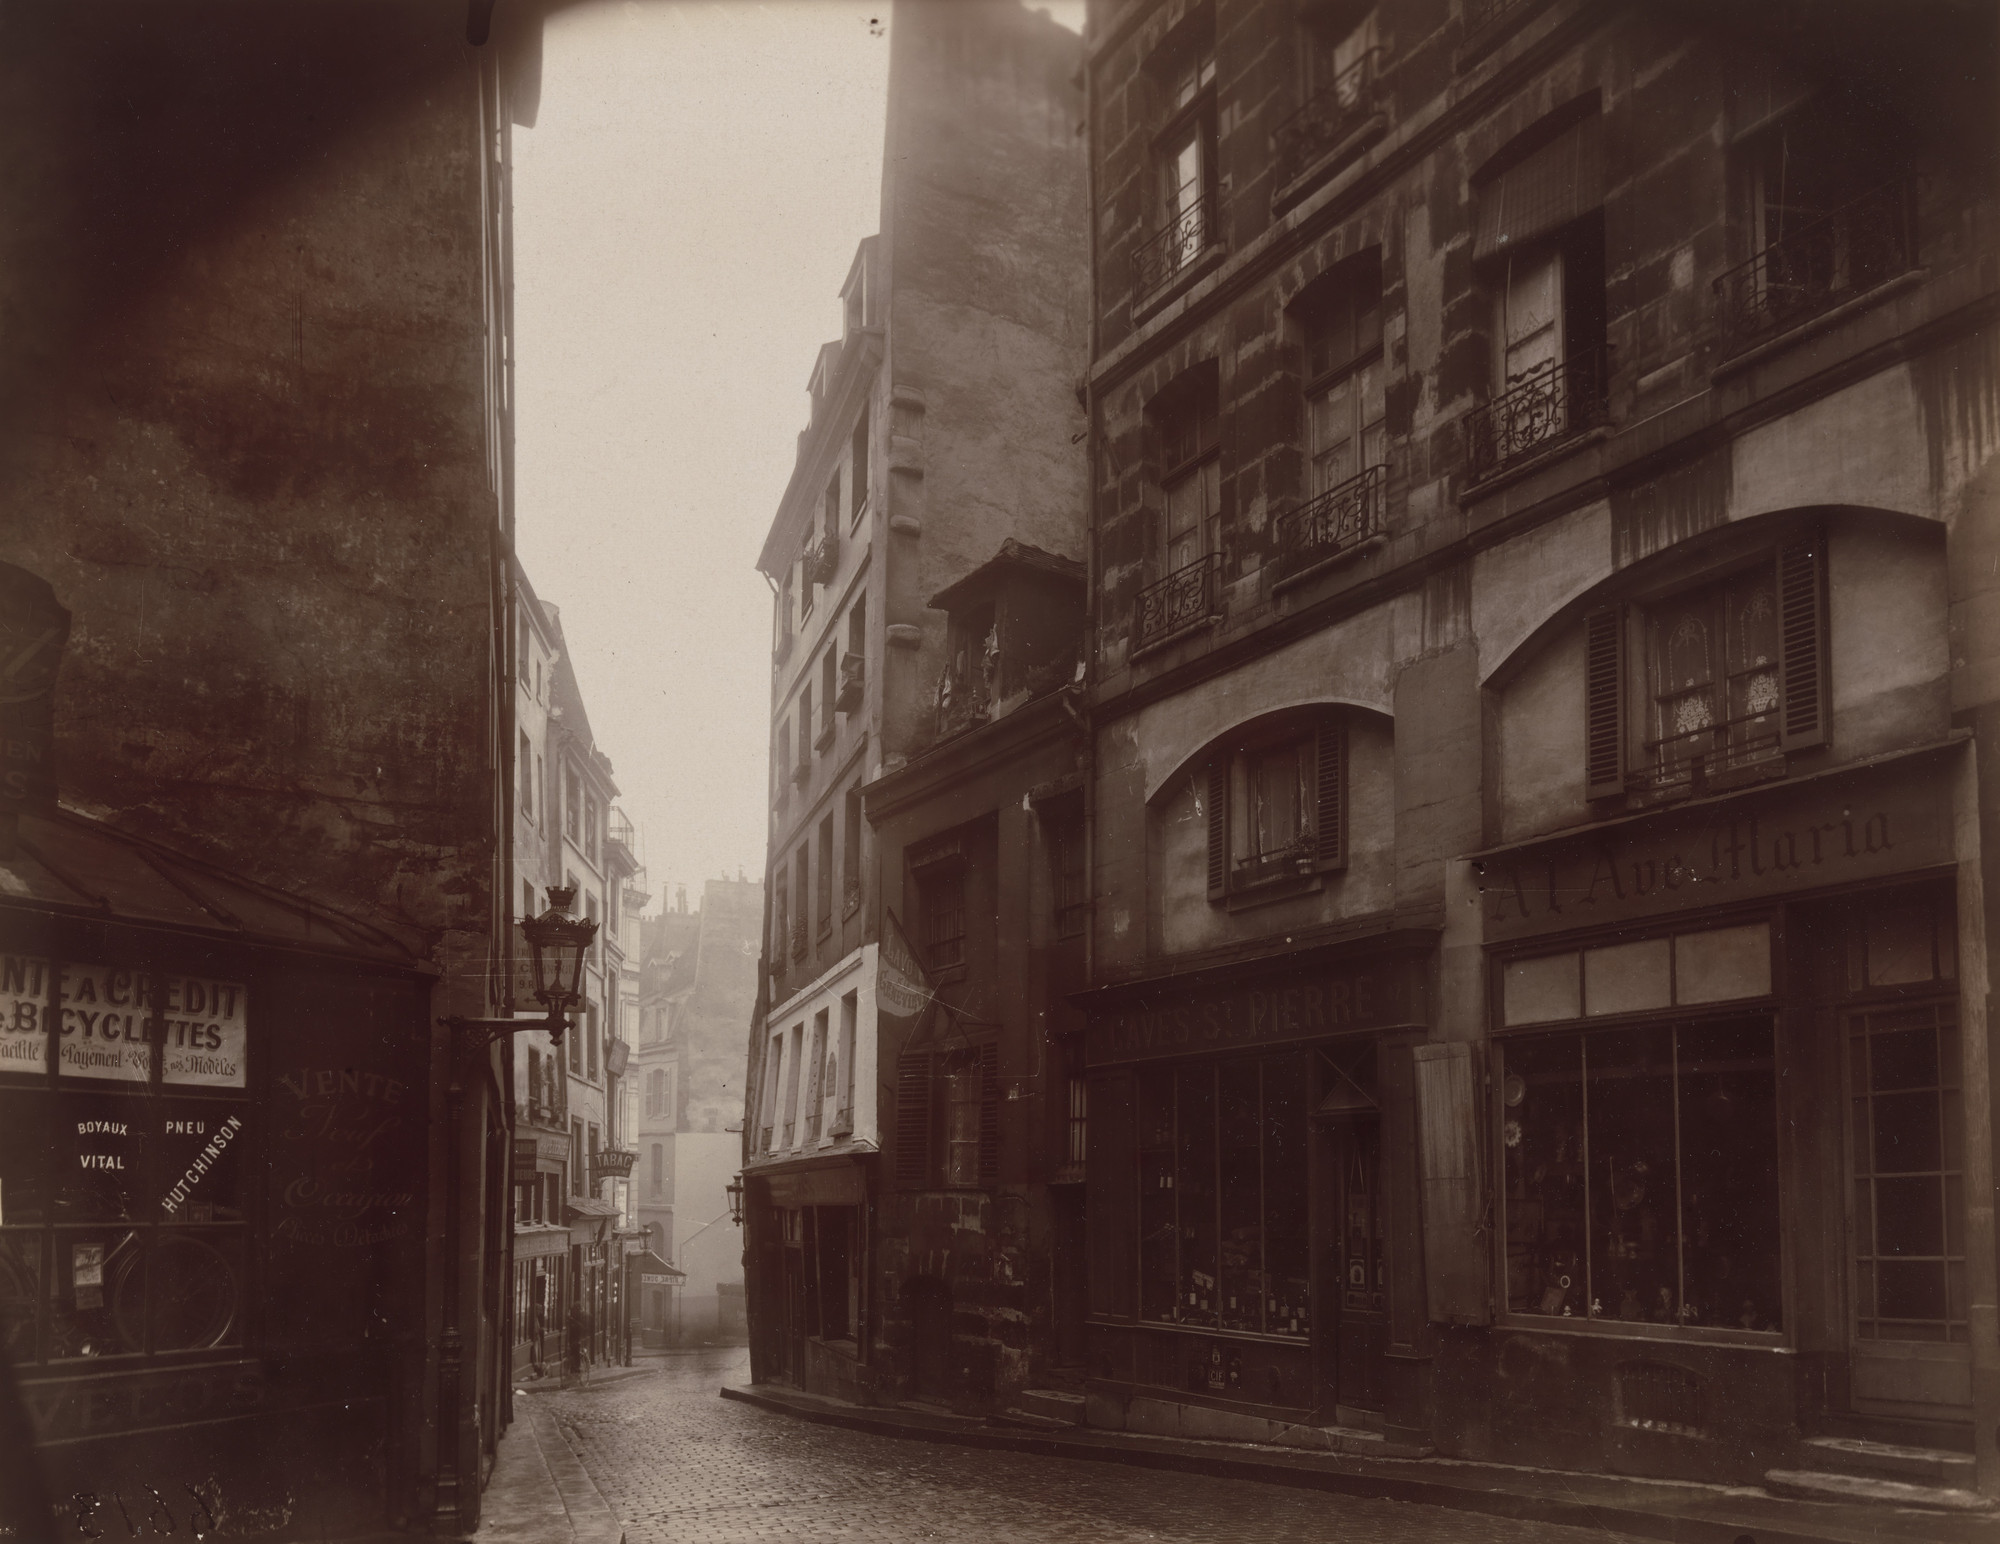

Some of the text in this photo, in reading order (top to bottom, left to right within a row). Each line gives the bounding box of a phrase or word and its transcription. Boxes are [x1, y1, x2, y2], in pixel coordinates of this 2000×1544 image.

[103, 966, 242, 1020] CREDIT
[1247, 976, 1375, 1040] PIERRE
[6, 1000, 222, 1051] BICYCLETTES
[282, 1067, 403, 1104] VENTE
[77, 1120, 205, 1137] BOYAUX PNEU
[80, 1154, 126, 1171] VITAL
[161, 1115, 243, 1214] HUTCHINSON
[595, 1153, 632, 1169] TABAC
